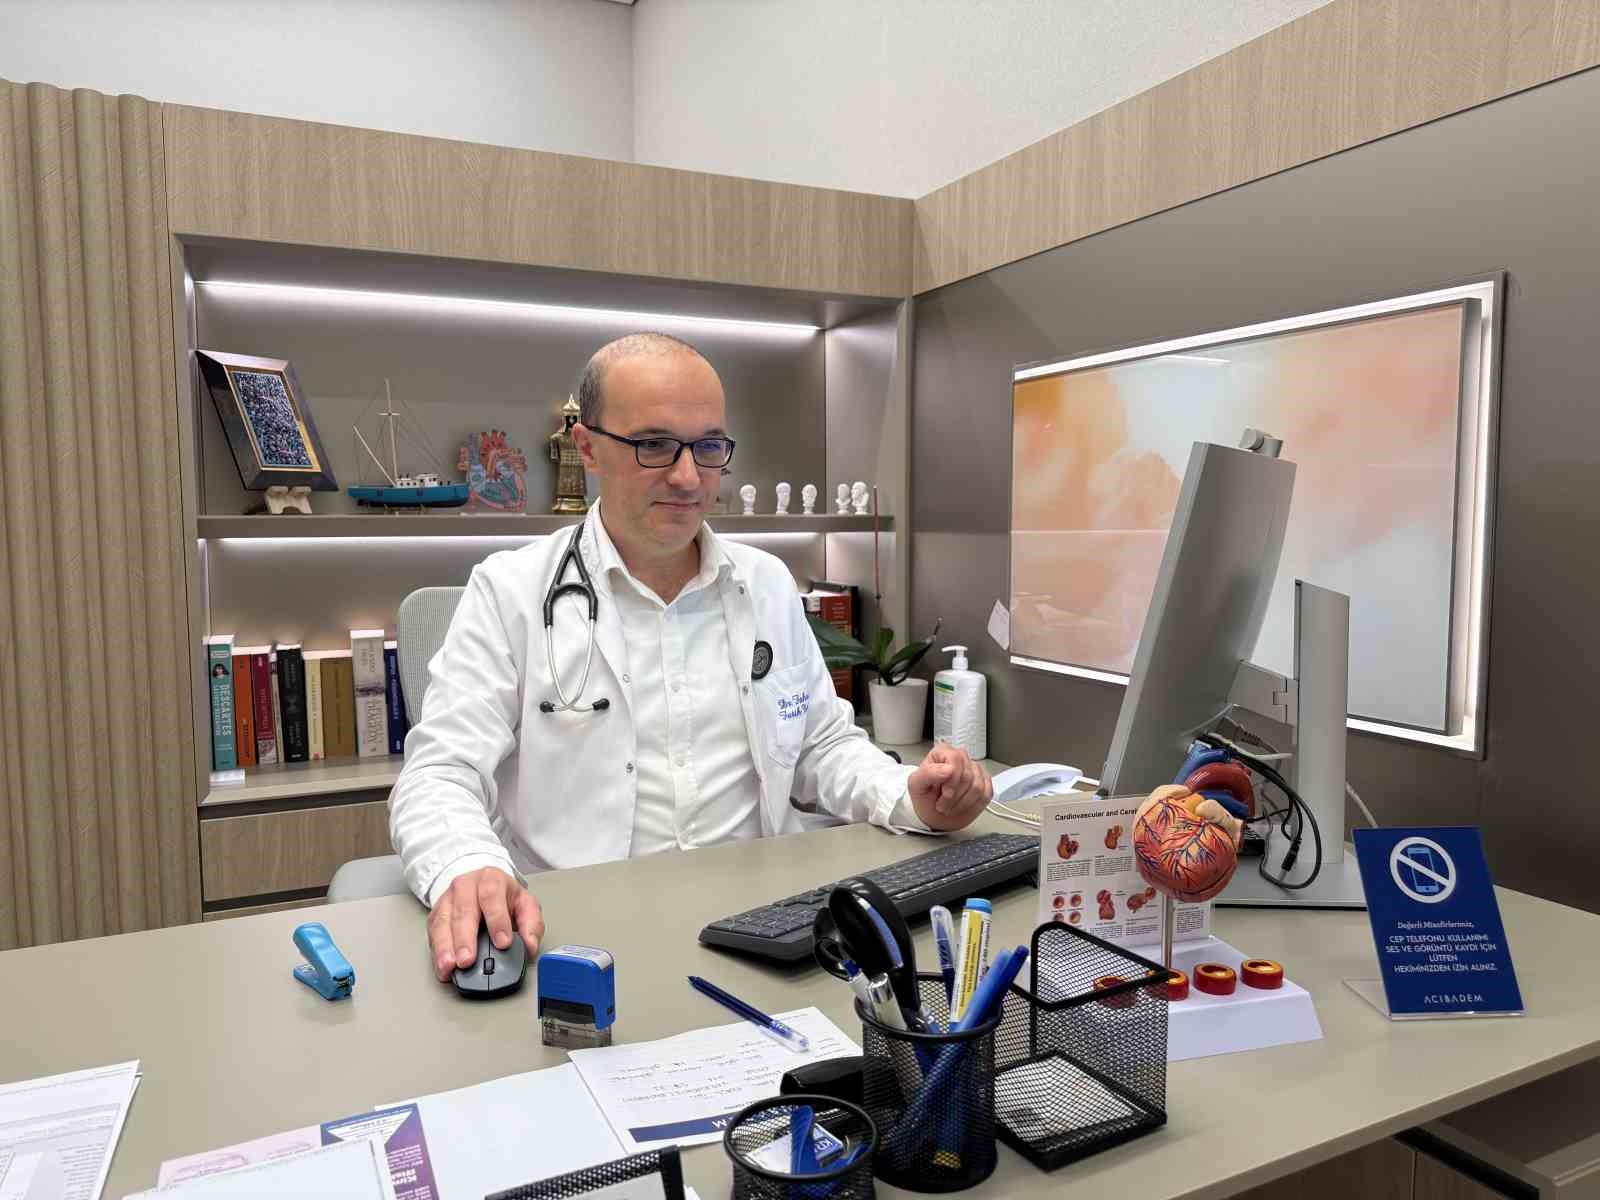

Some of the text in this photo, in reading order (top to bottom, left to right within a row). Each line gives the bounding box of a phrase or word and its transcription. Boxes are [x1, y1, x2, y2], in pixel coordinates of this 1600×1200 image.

[220, 684, 232, 737] DESCARTES
[1055, 811, 1104, 821] Cardiovascular
[1105, 809, 1118, 817] and
[1397, 920, 1422, 930] Değerli
[1389, 935, 1404, 943] CEP
[1406, 935, 1445, 943] TELEFONU
[1386, 945, 1400, 953] SES
[1414, 943, 1453, 952] GÖRÜNTÜ
[1455, 943, 1478, 952] KAYDI
[1429, 953, 1458, 961] LÜTFEN
[1424, 993, 1483, 1004] ACIBADEM
